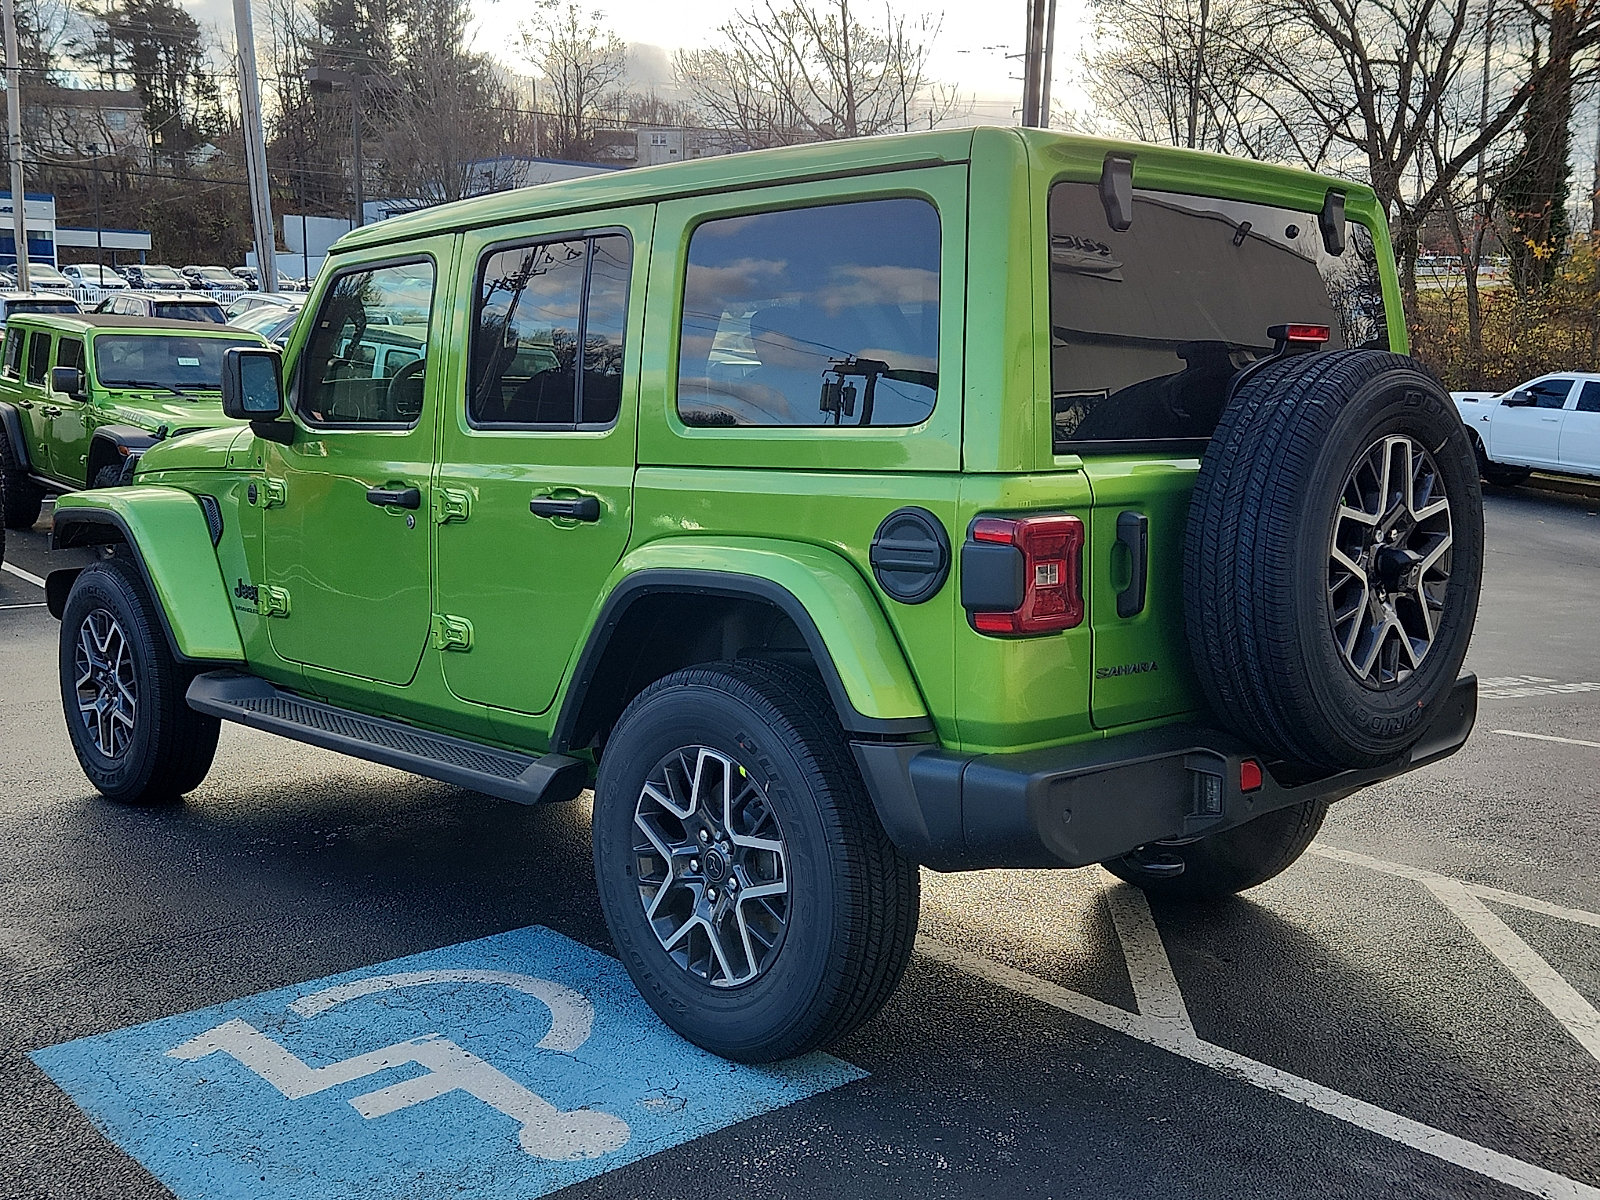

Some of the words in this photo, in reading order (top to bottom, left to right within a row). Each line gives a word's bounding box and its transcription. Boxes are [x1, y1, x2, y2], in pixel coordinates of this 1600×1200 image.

[234, 577, 258, 605] Jeep
[235, 605, 259, 615] WRANGLE
[1096, 661, 1158, 680] SAHARA
